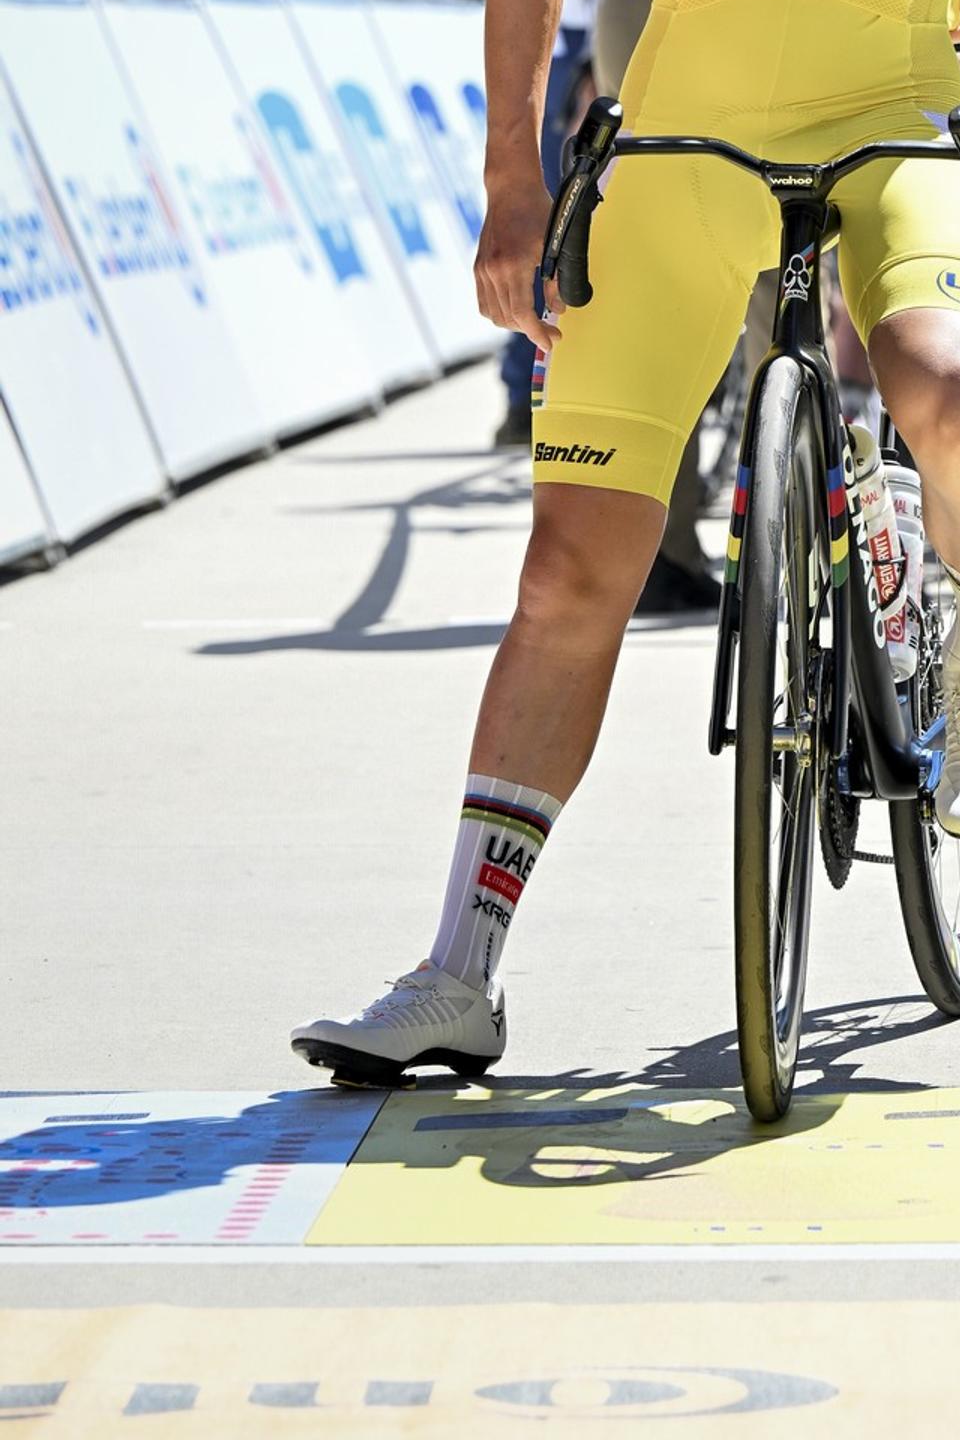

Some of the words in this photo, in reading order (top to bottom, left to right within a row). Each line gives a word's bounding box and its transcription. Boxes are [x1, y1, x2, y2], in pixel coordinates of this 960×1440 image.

[769, 175, 813, 186] wahoo
[533, 441, 618, 466] Santini
[874, 534, 895, 582] ENRVIT
[484, 834, 536, 883] UAE
[471, 893, 512, 929] XRG
